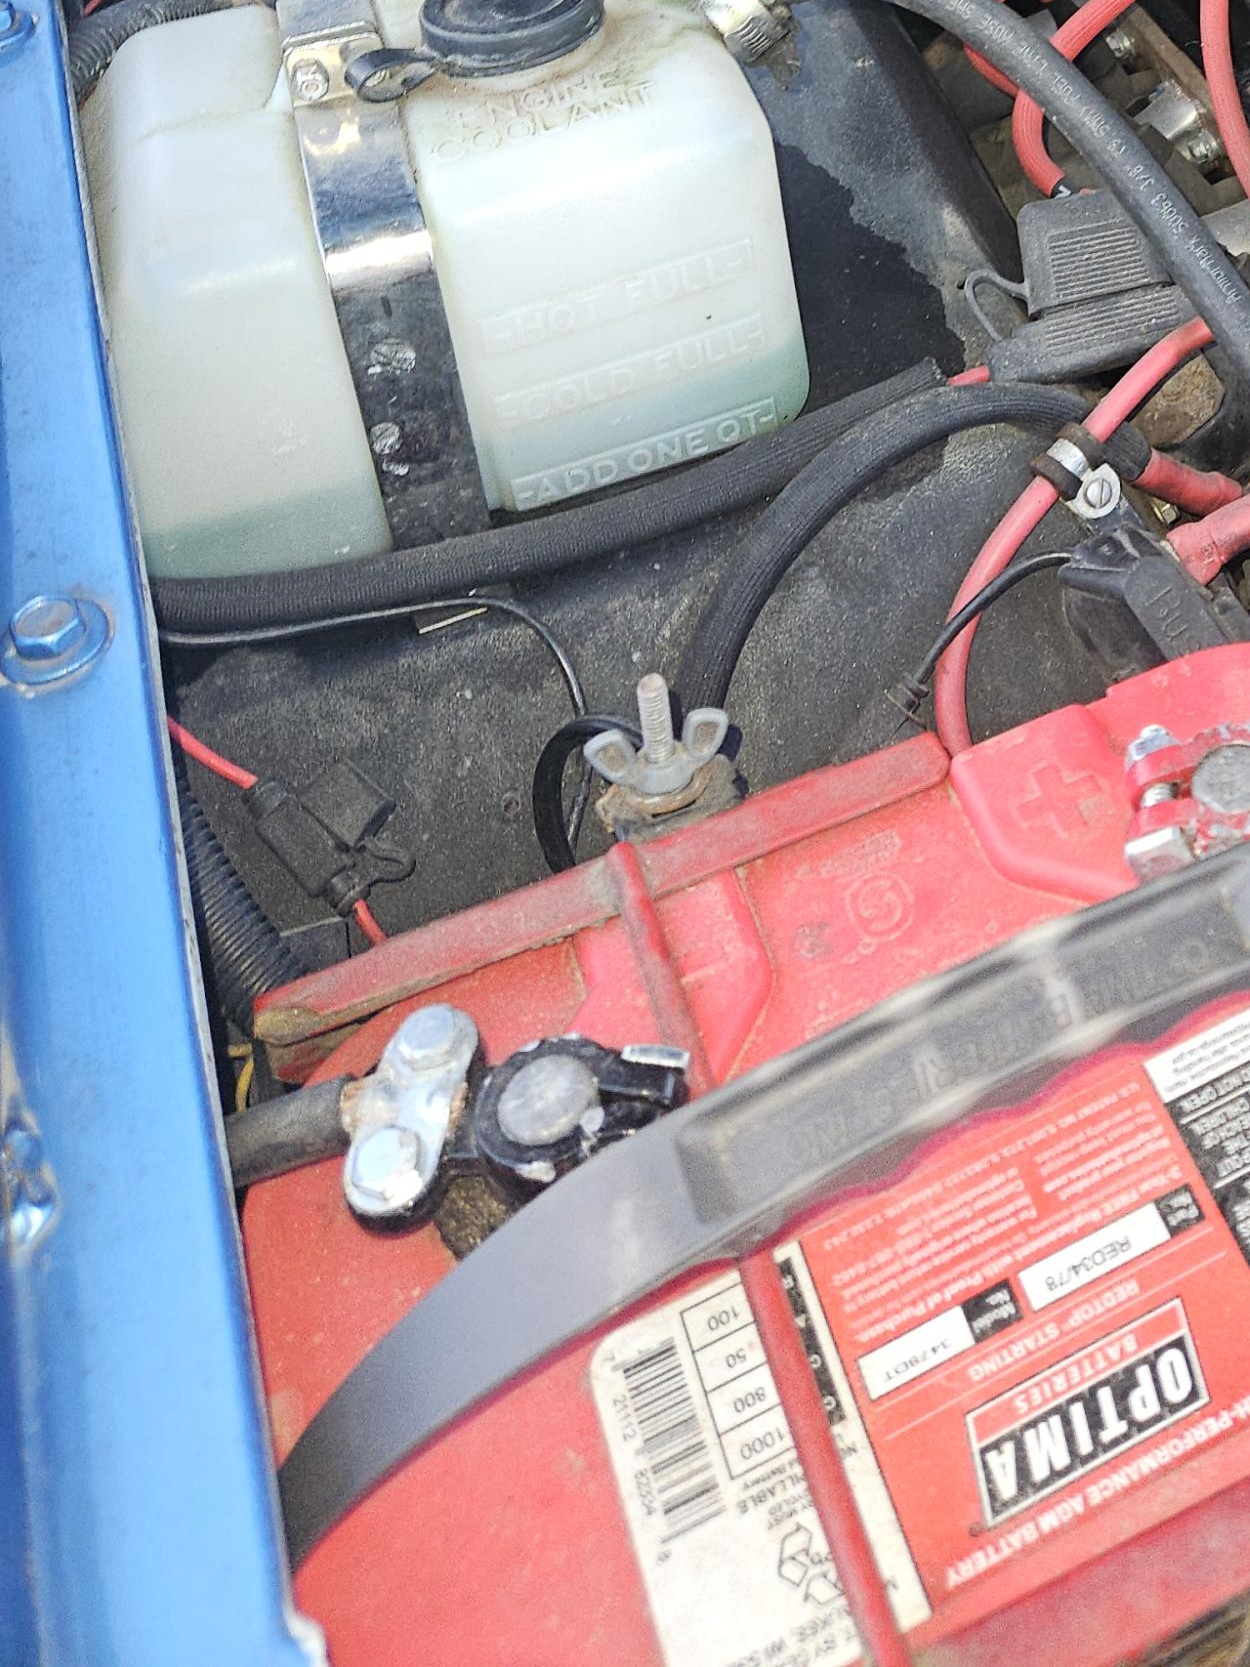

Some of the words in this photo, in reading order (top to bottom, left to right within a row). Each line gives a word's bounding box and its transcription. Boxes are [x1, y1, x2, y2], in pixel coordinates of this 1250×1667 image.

[444, 65, 632, 128] ENGINE
[434, 80, 656, 162] COOLANT
[627, 429, 709, 476] ONE
[1041, 1233, 1134, 1293] RED34/78
[703, 1303, 740, 1333] 100
[968, 1299, 1017, 1334] Model
[723, 1346, 749, 1369] 50
[964, 1320, 1062, 1383] STARTING
[1009, 1329, 1141, 1417] BATTERIES
[610, 1394, 637, 1442] 21112
[730, 1384, 769, 1415] 800
[736, 1423, 787, 1462] 1000
[974, 1342, 1204, 1506] OPTIMA
[1033, 1492, 1089, 1535] AGM
[938, 1517, 1041, 1589] BATTERY
